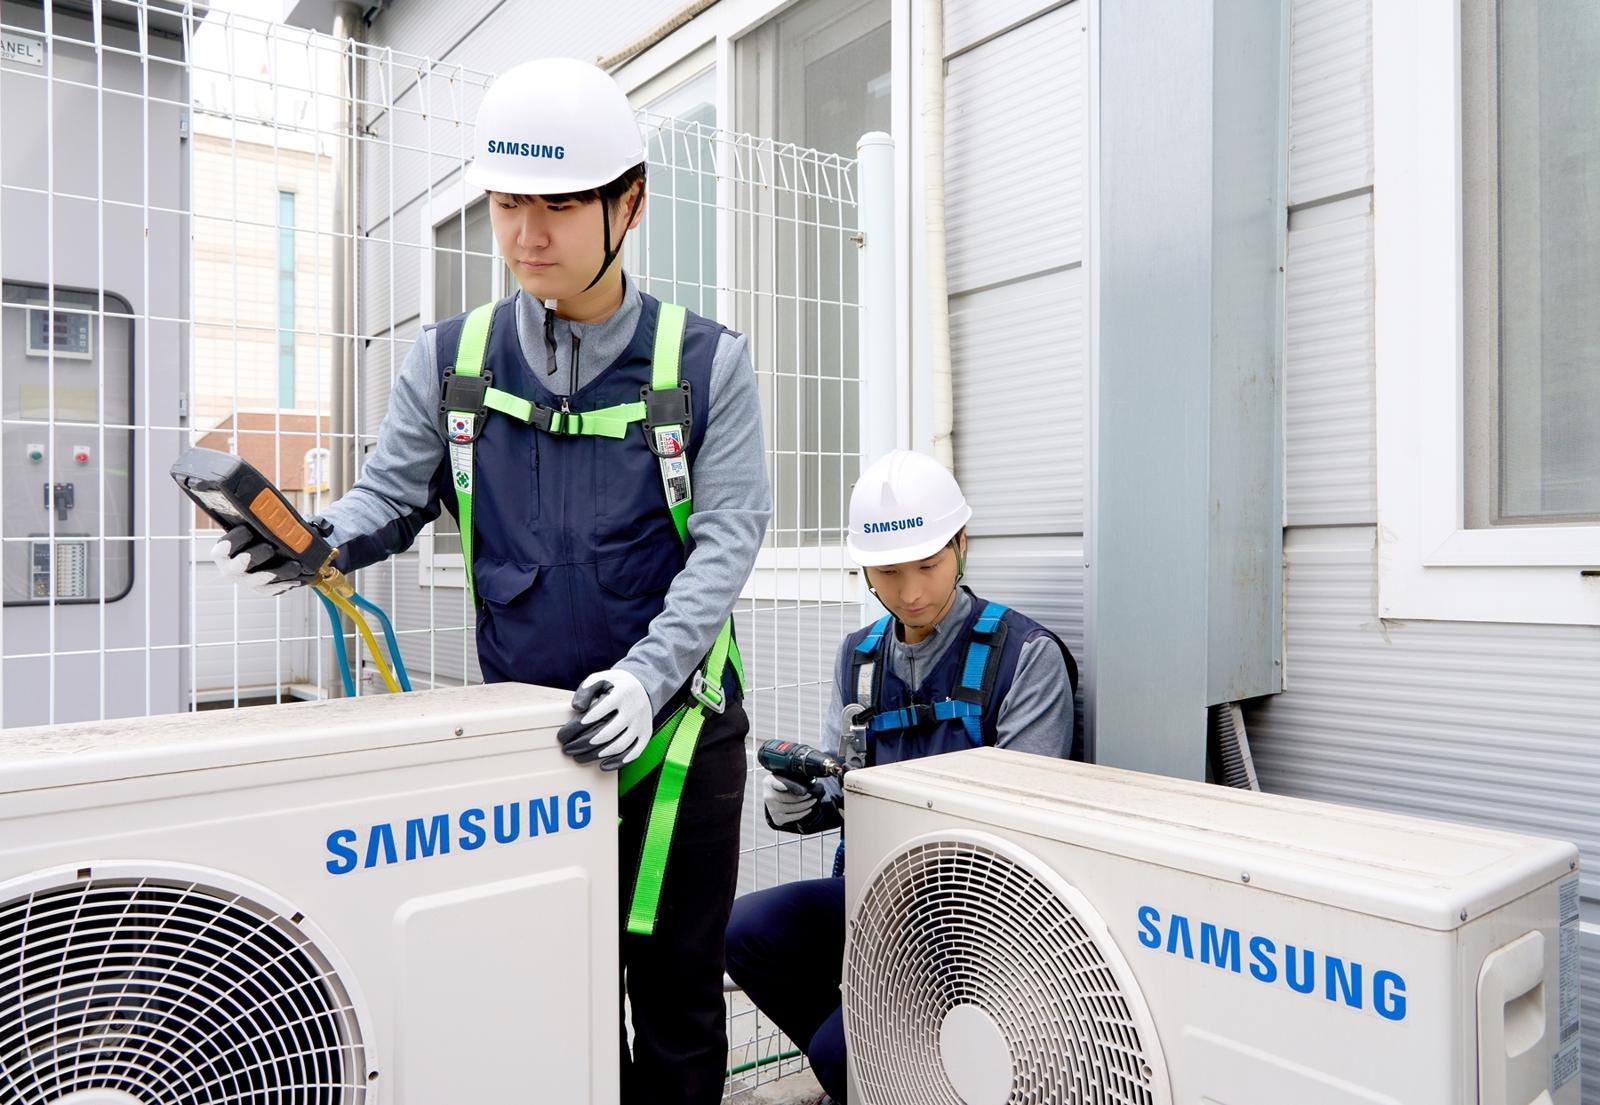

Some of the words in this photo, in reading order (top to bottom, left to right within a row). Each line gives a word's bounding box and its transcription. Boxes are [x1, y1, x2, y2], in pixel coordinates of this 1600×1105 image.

[488, 140, 565, 160] SAMSUNG
[864, 517, 924, 533] SAMSUNG
[326, 790, 592, 875] SAMSUNG
[1138, 905, 1407, 1021] SAMSUNG
